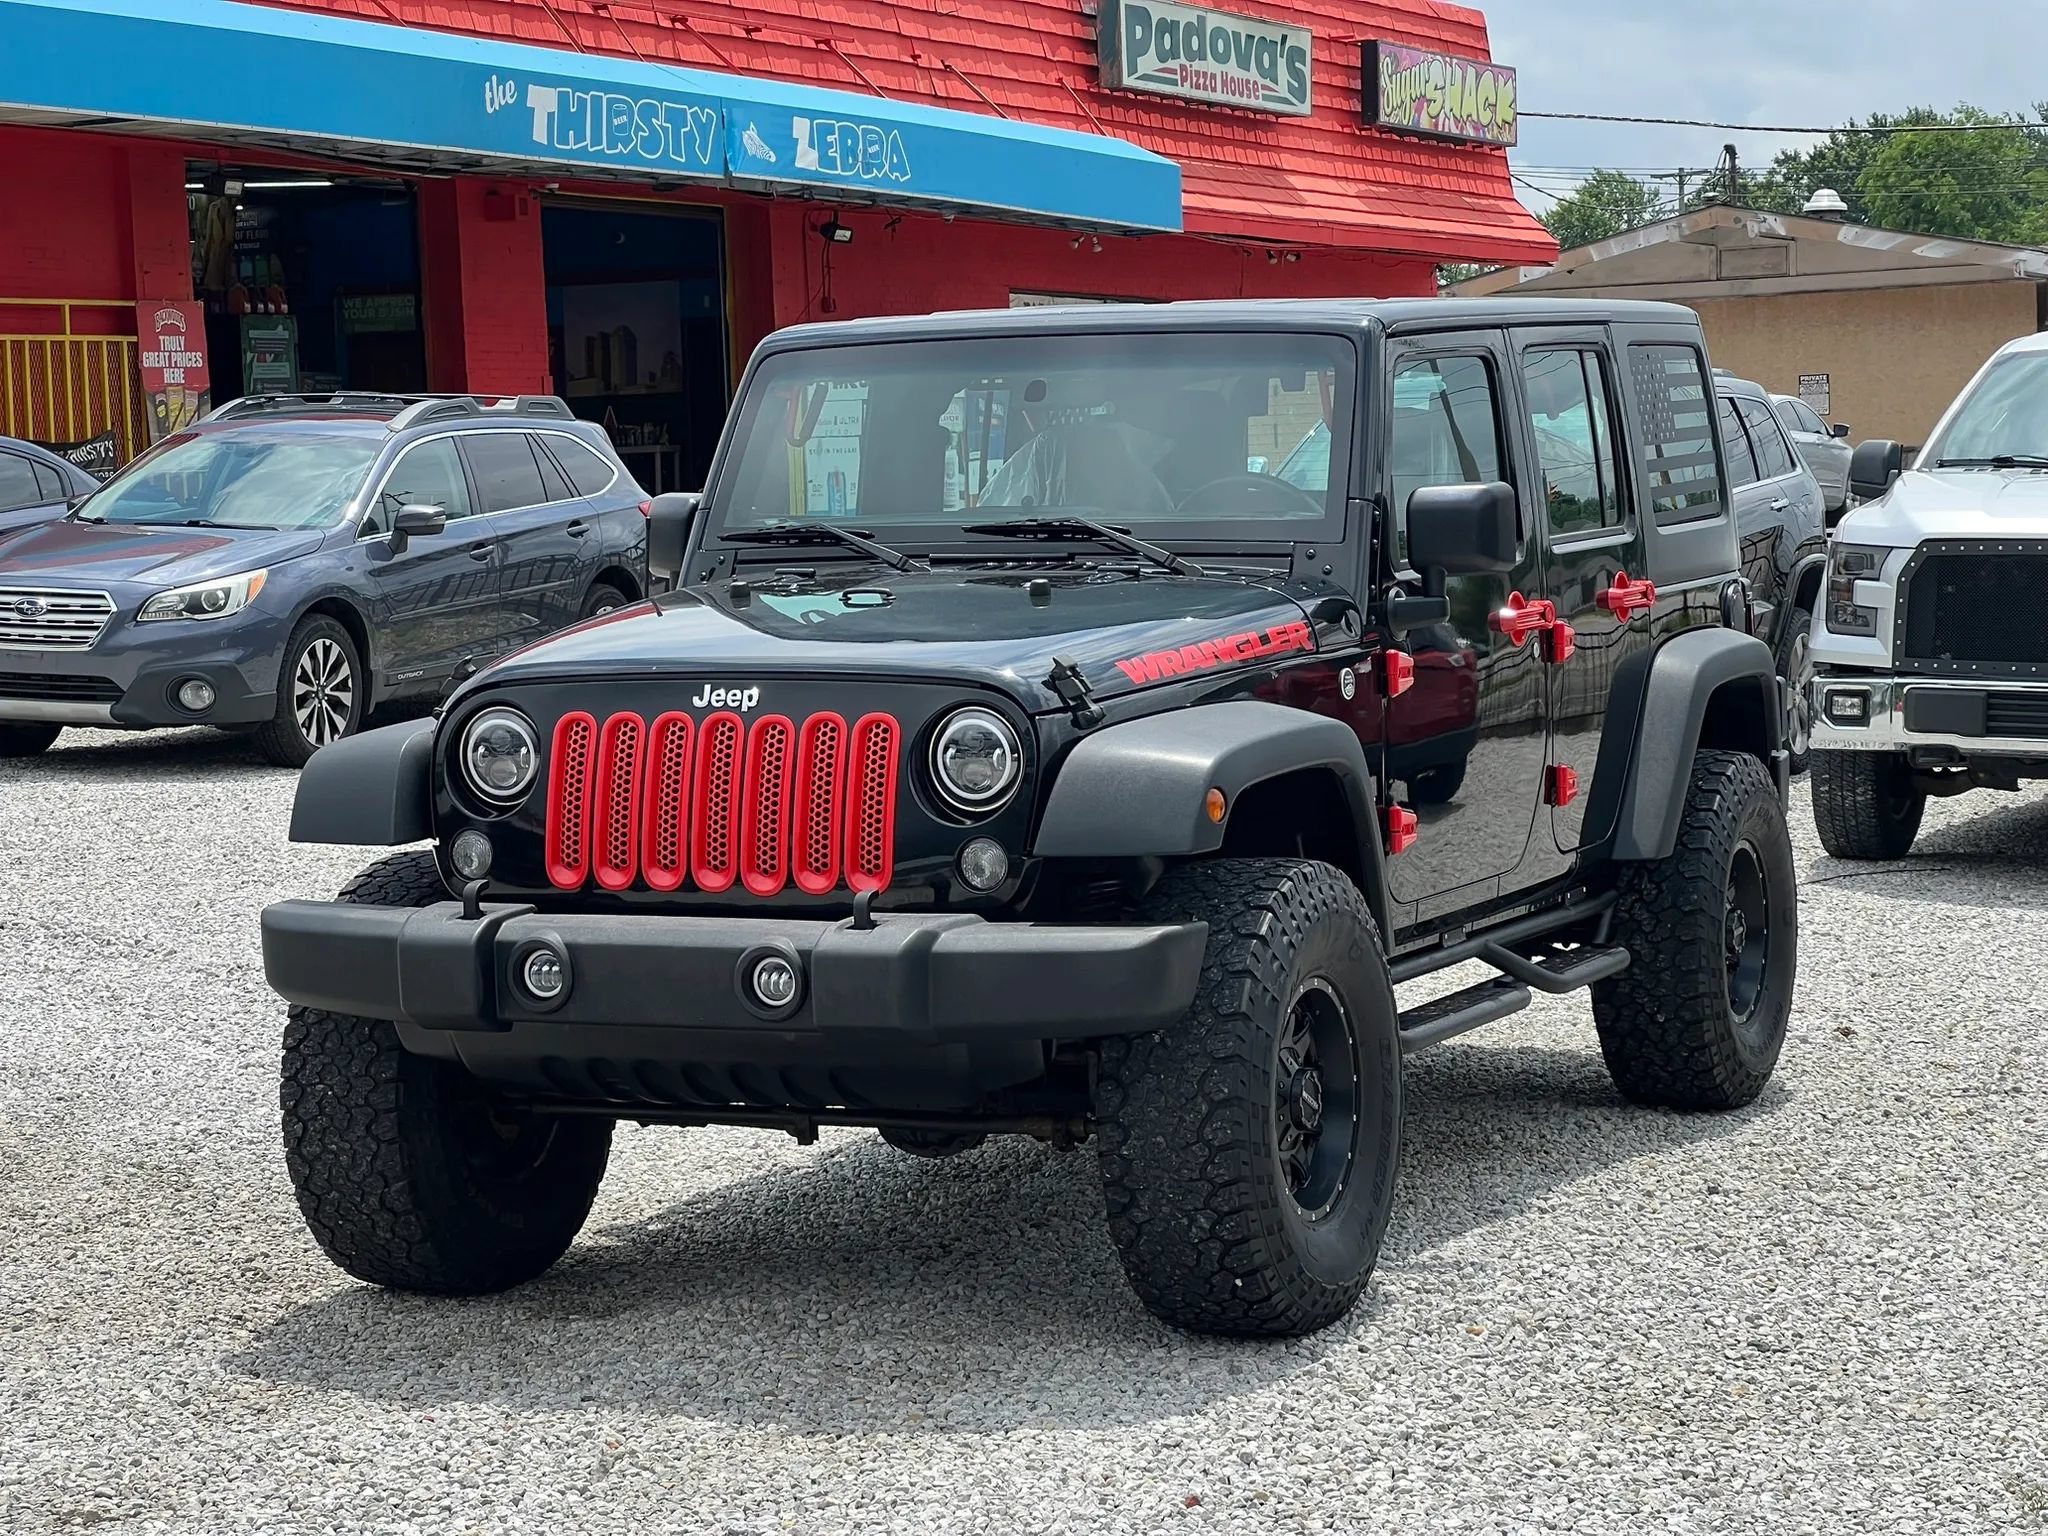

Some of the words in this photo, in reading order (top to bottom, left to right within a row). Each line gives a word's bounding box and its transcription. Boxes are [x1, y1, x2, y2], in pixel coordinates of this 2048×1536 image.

[1124, 4, 1307, 105] Padova's
[1179, 63, 1217, 94] Pizza
[1221, 71, 1260, 100] House
[1381, 55, 1429, 126] Sugar
[1426, 58, 1516, 130] SHACK
[484, 74, 518, 114] the
[526, 84, 717, 165] THIRSTY
[792, 116, 911, 183] ZEBRA
[158, 335, 185, 351] TRULY
[143, 352, 169, 367] GREAT
[171, 352, 203, 367] PRICES
[163, 368, 185, 384] HERE
[65, 440, 114, 463] THIRSTY'S
[1114, 619, 1316, 685] WRANGLER
[397, 670, 424, 680] OUTBACK
[692, 684, 760, 712] Jeep
